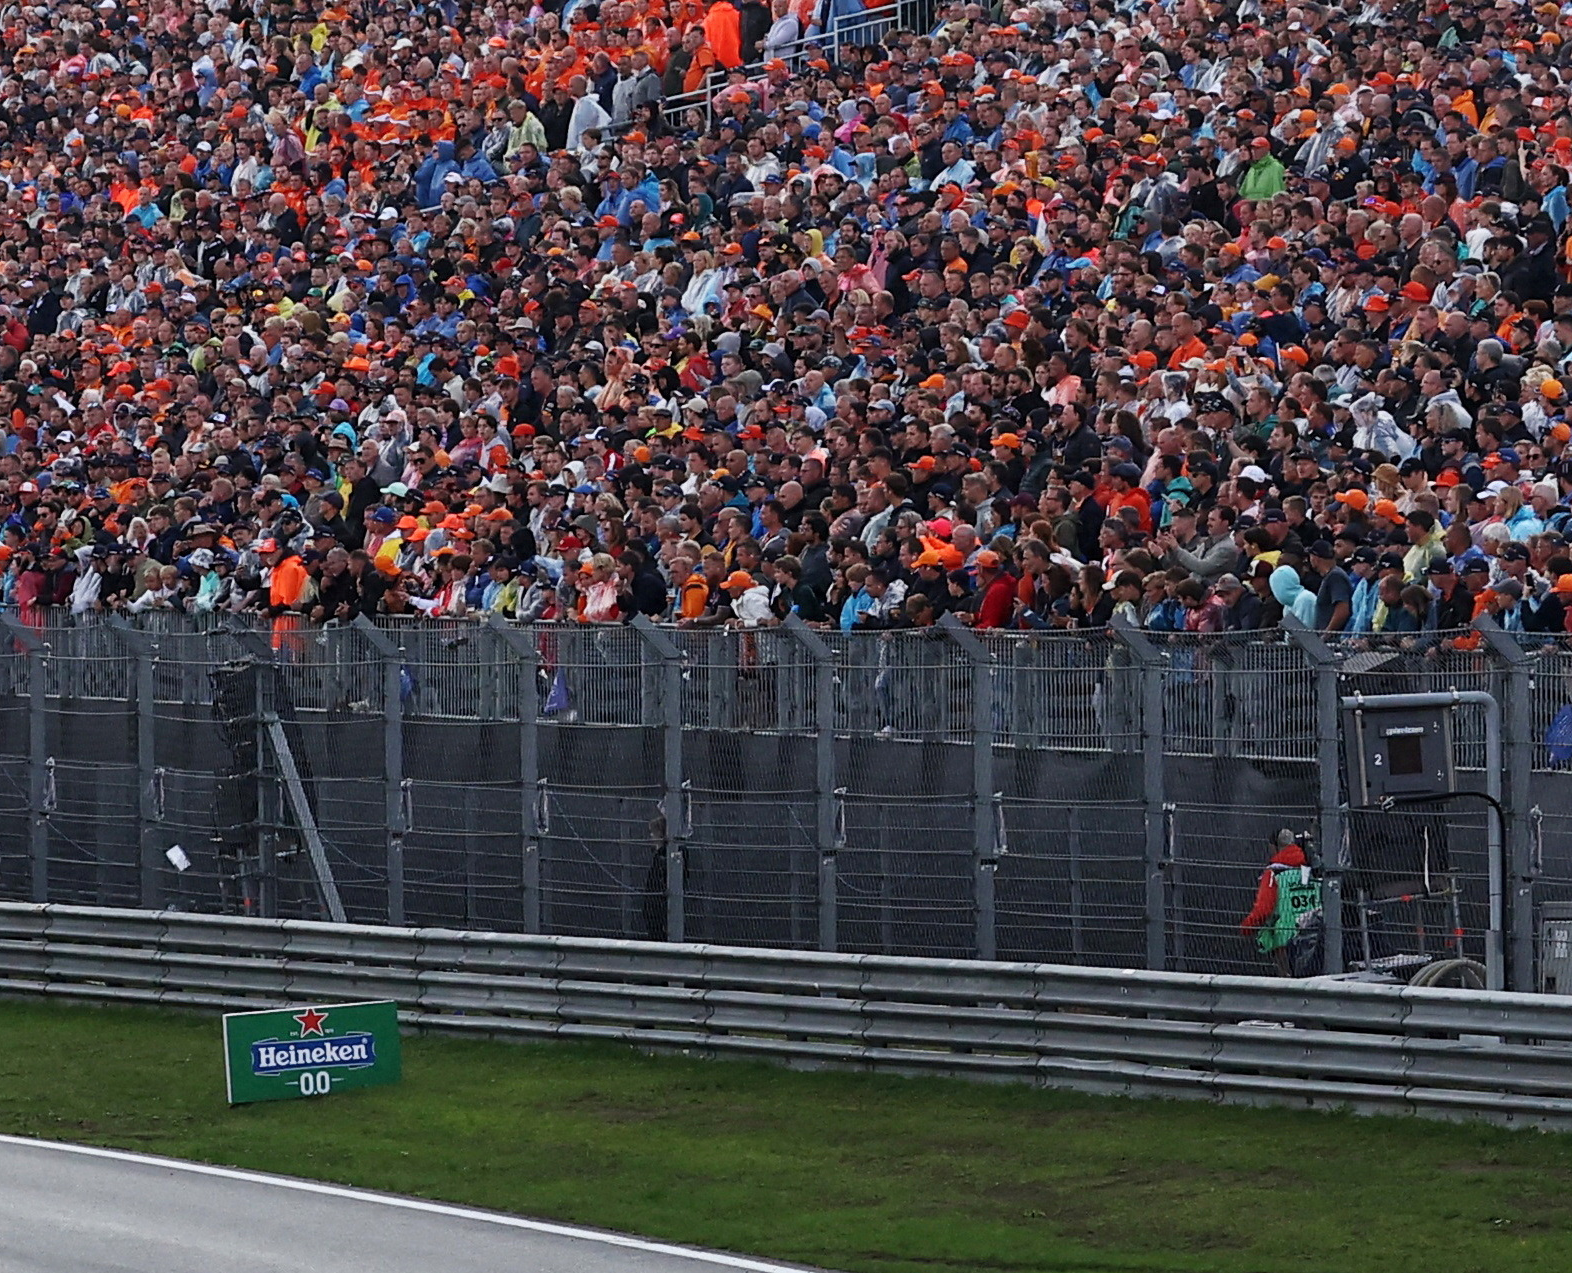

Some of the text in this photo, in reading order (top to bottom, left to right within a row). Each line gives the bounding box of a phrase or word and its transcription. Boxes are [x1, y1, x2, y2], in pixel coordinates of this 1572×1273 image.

[1374, 754, 1382, 766] 2
[259, 1042, 368, 1068] Heineken
[300, 1071, 331, 1095] 0.0
